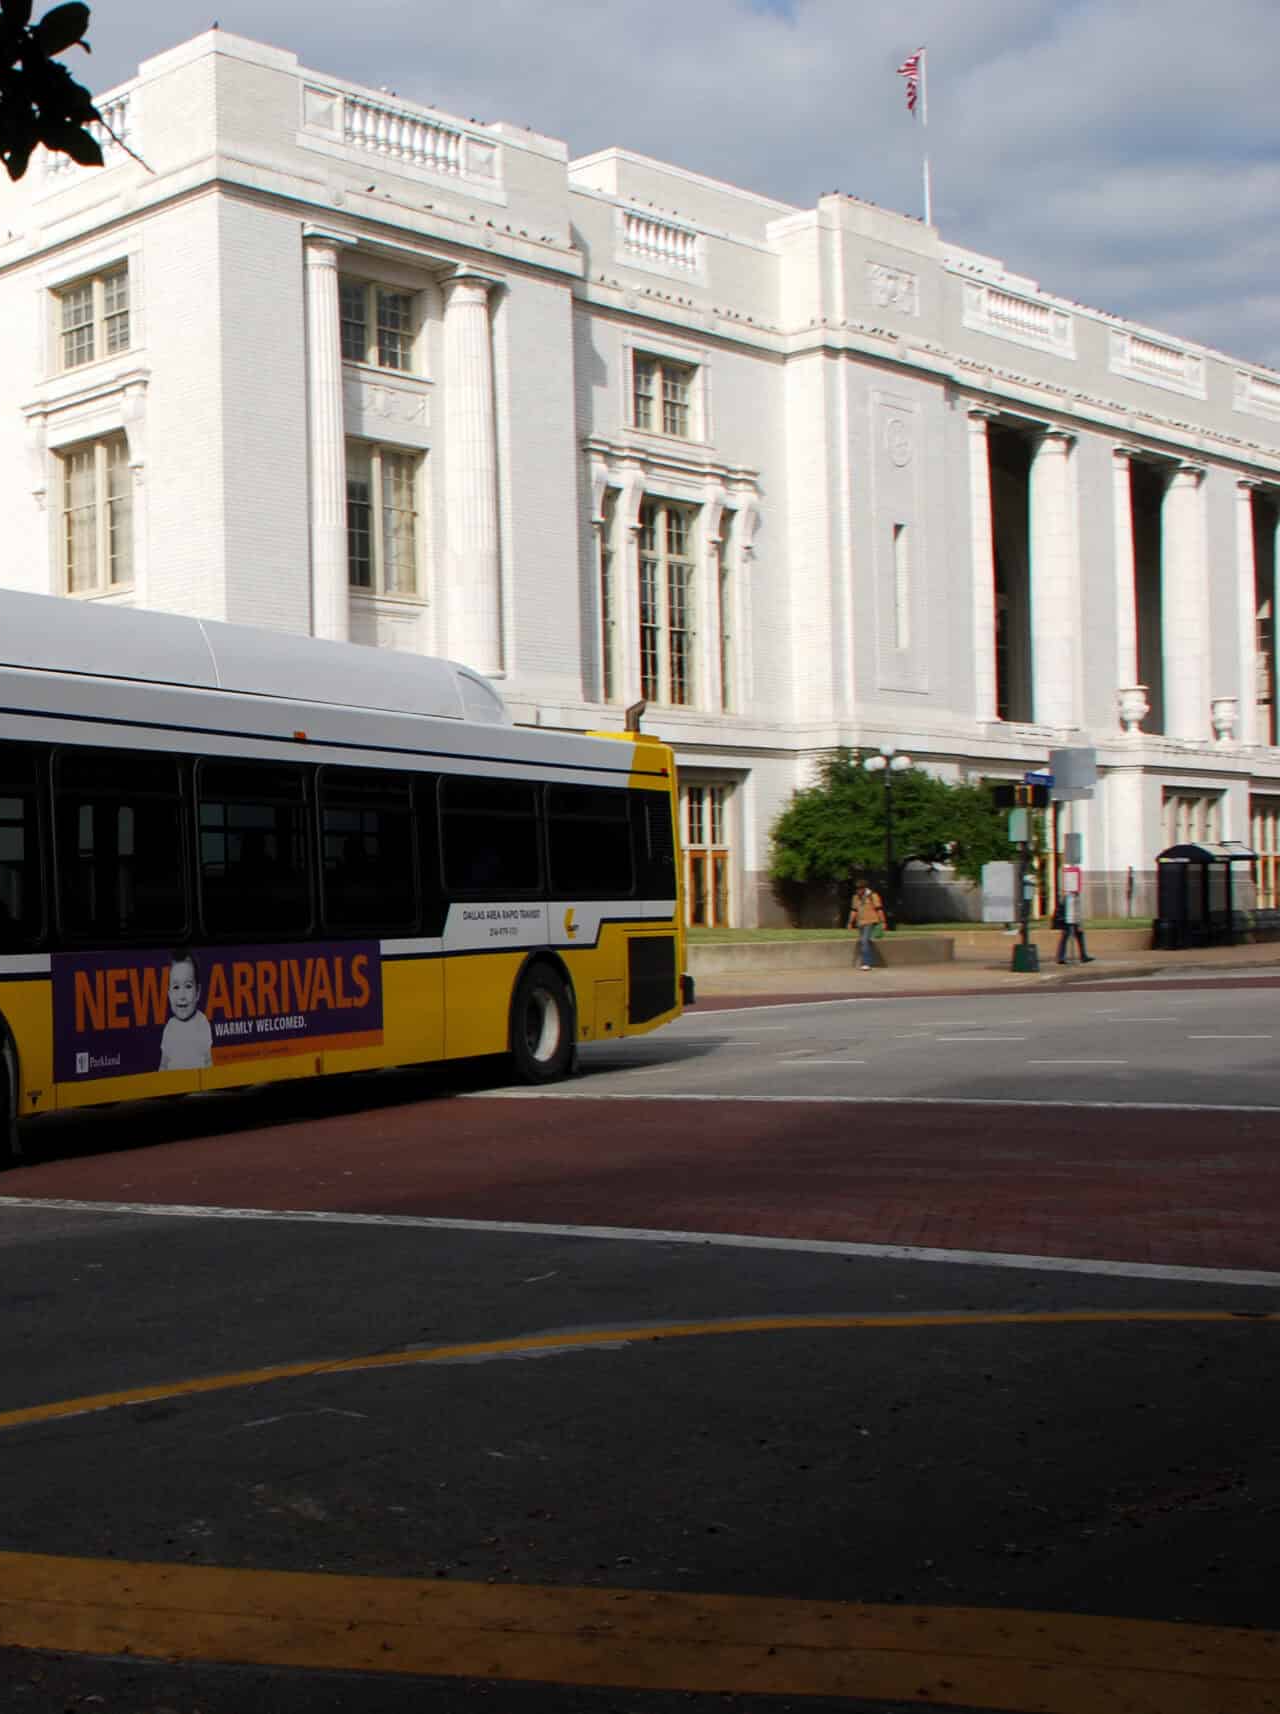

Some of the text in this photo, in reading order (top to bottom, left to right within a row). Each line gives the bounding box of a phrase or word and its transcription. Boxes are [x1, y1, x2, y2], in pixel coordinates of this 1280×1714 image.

[463, 910, 484, 920] DALLAS
[486, 910, 501, 920] AREA
[74, 954, 370, 1032] NEW ARRIVALS
[215, 1015, 307, 1038] WARMLY WELCOMED.
